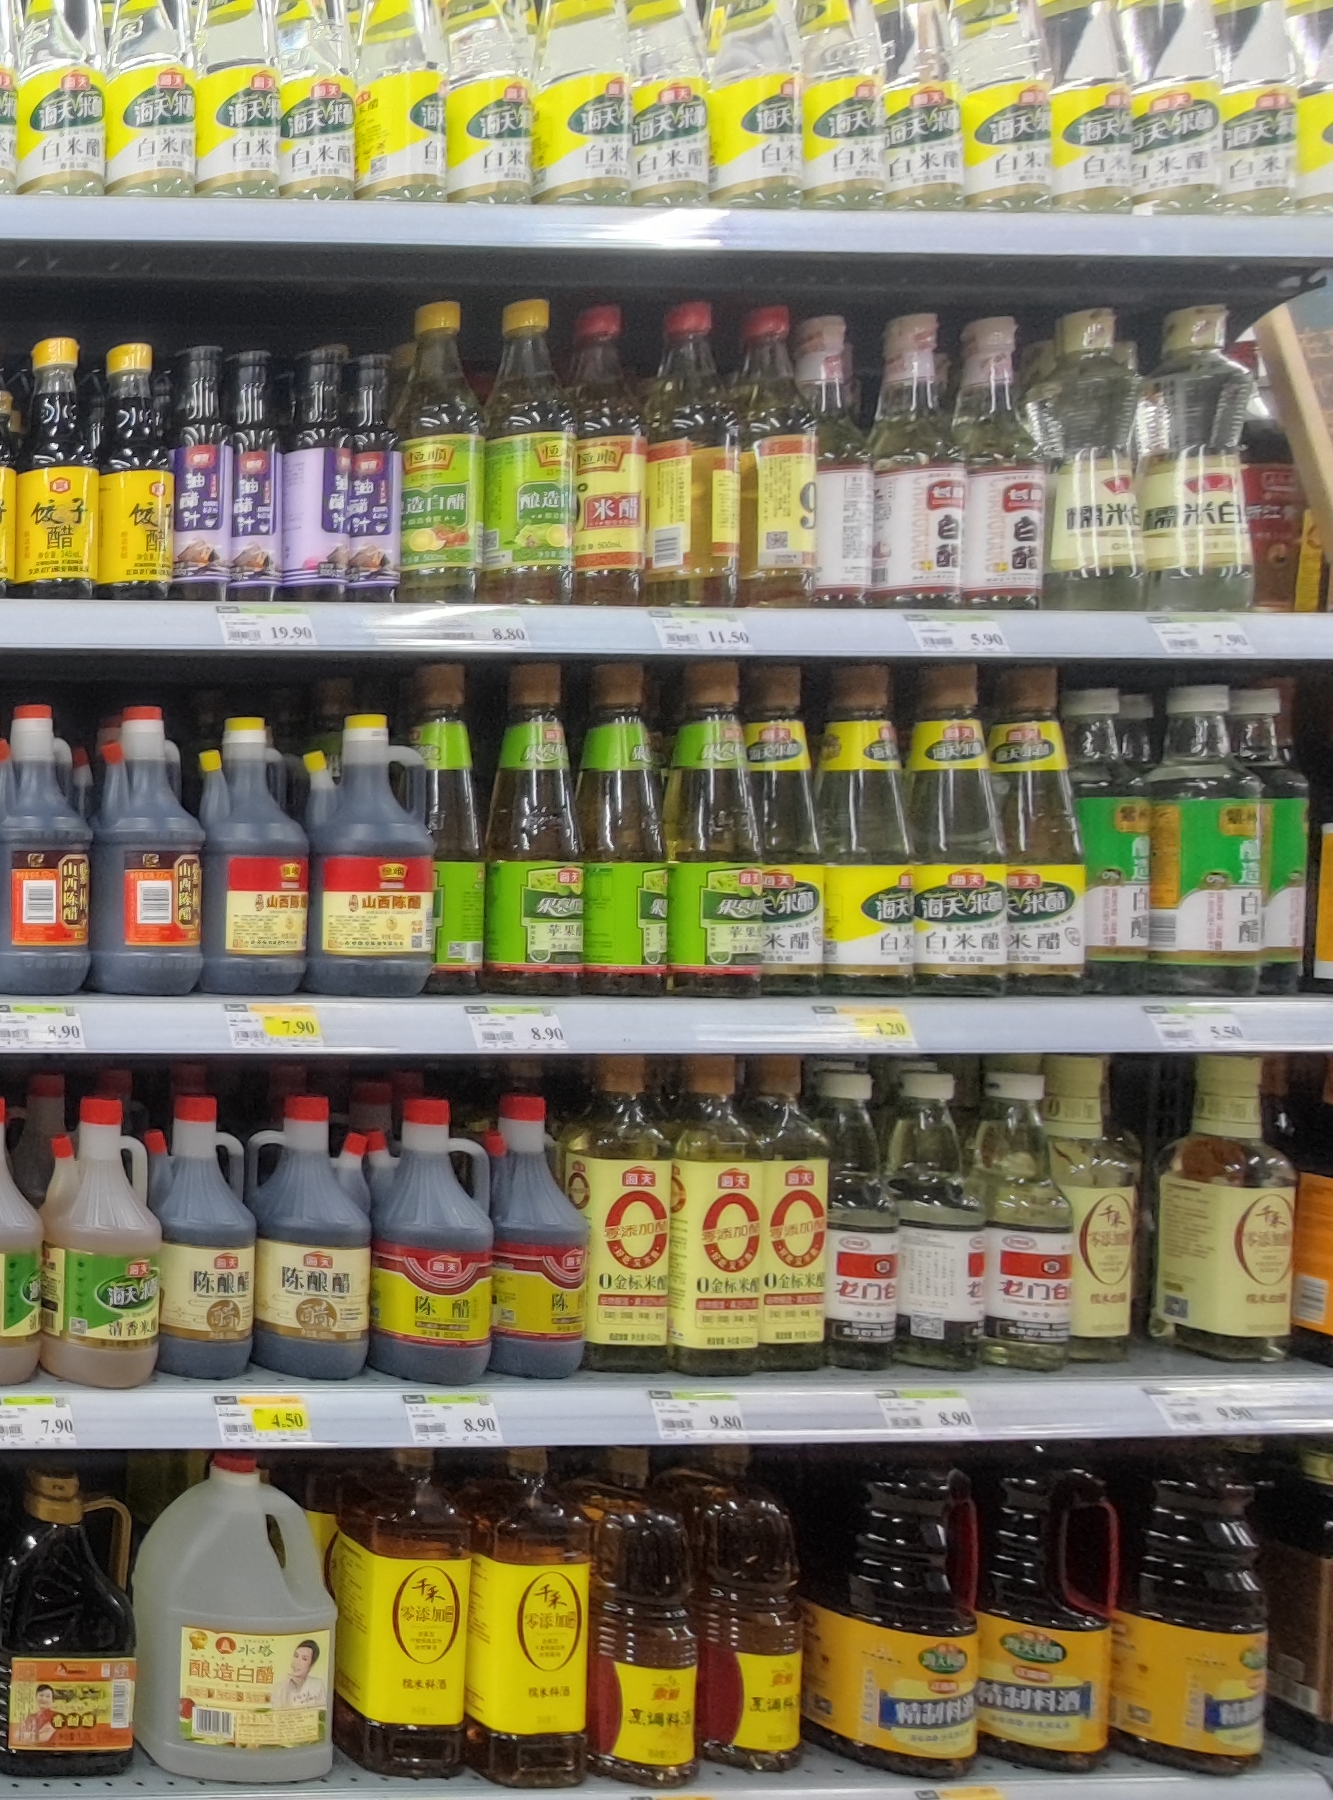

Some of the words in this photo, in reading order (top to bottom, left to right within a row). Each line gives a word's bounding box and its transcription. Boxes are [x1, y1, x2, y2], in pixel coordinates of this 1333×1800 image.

[31, 497, 88, 526] 饺子
[47, 524, 72, 549] 醋
[270, 625, 312, 640] 19.90
[492, 627, 525, 641] 8.80
[971, 633, 1003, 648] 5.90
[925, 930, 1000, 950] 白米醋
[48, 1024, 80, 1039] 8.90
[281, 1021, 314, 1035] 7.90
[531, 1026, 564, 1041] 8.90
[874, 1022, 906, 1037] 4.20
[271, 1413, 303, 1428] 4.50
[463, 1417, 496, 1432] 8.90
[709, 1415, 742, 1429] 9.80
[938, 1411, 971, 1426] 8.90
[40, 1419, 73, 1434] 7.90
[189, 1660, 274, 1684] 酿造白醋
